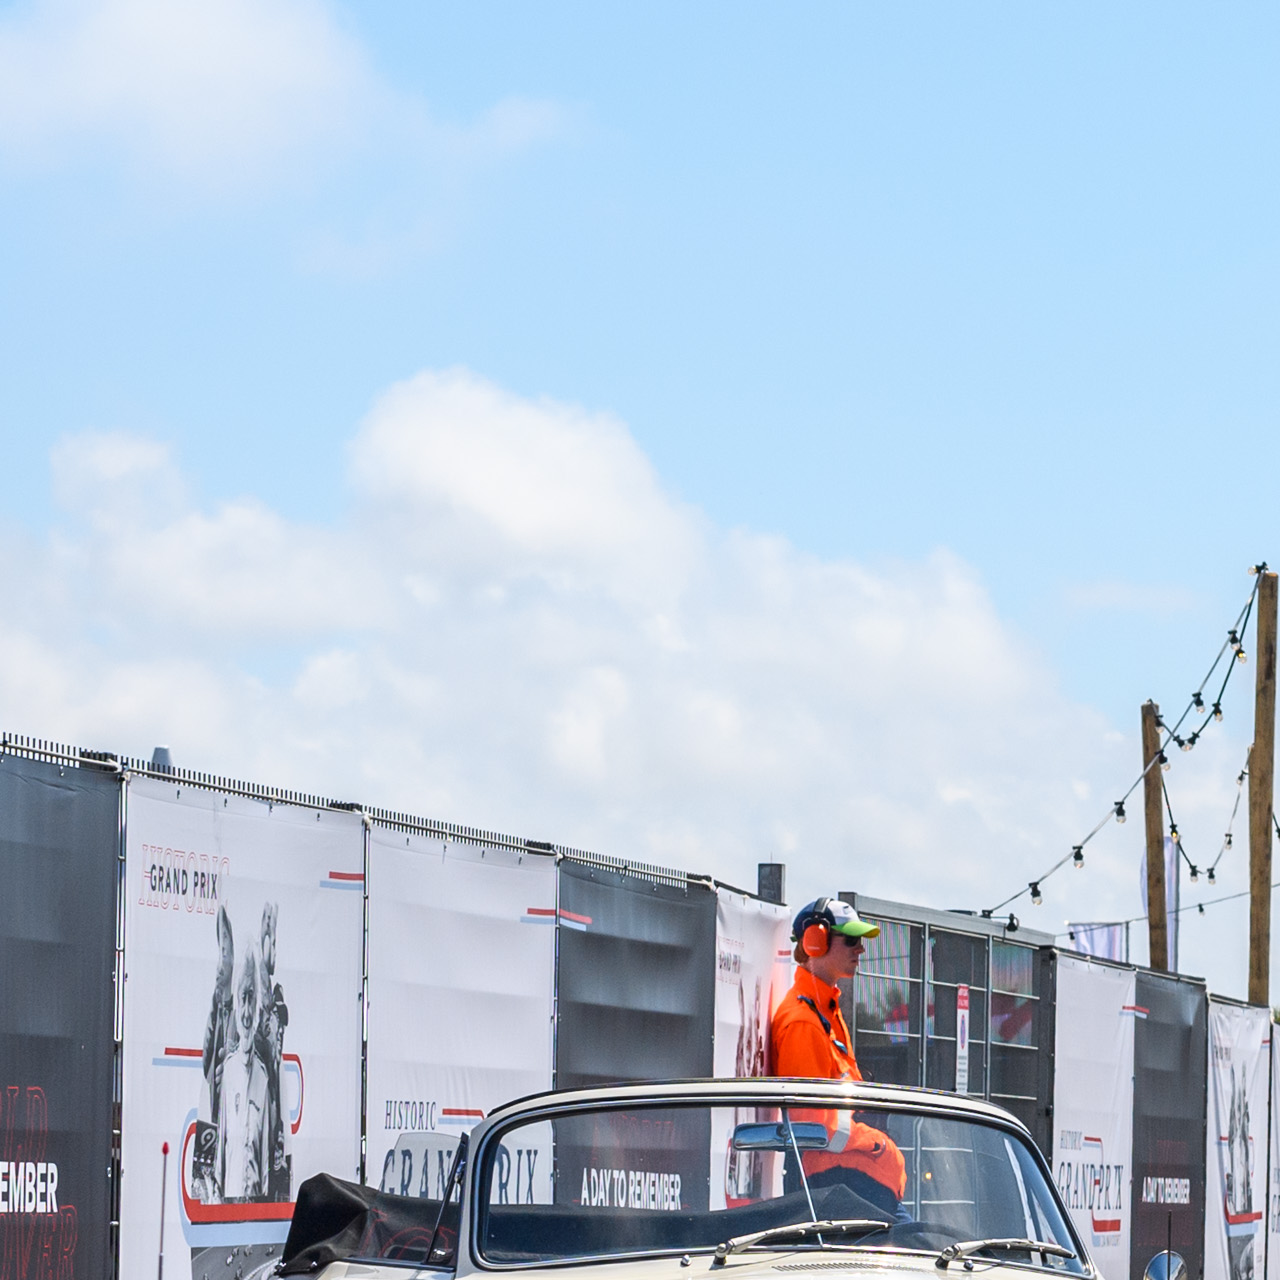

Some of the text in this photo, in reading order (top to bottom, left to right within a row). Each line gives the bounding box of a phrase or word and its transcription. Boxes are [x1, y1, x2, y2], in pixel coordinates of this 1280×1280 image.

[150, 863, 218, 900] GRAND PRIX
[385, 1100, 437, 1131] HISTORIC
[381, 1149, 457, 1201] GRAN
[581, 1167, 682, 1210] A DAY TO REMEMBER
[1058, 1160, 1095, 1210] GRAND
[1097, 1163, 1123, 1210] PRIX
